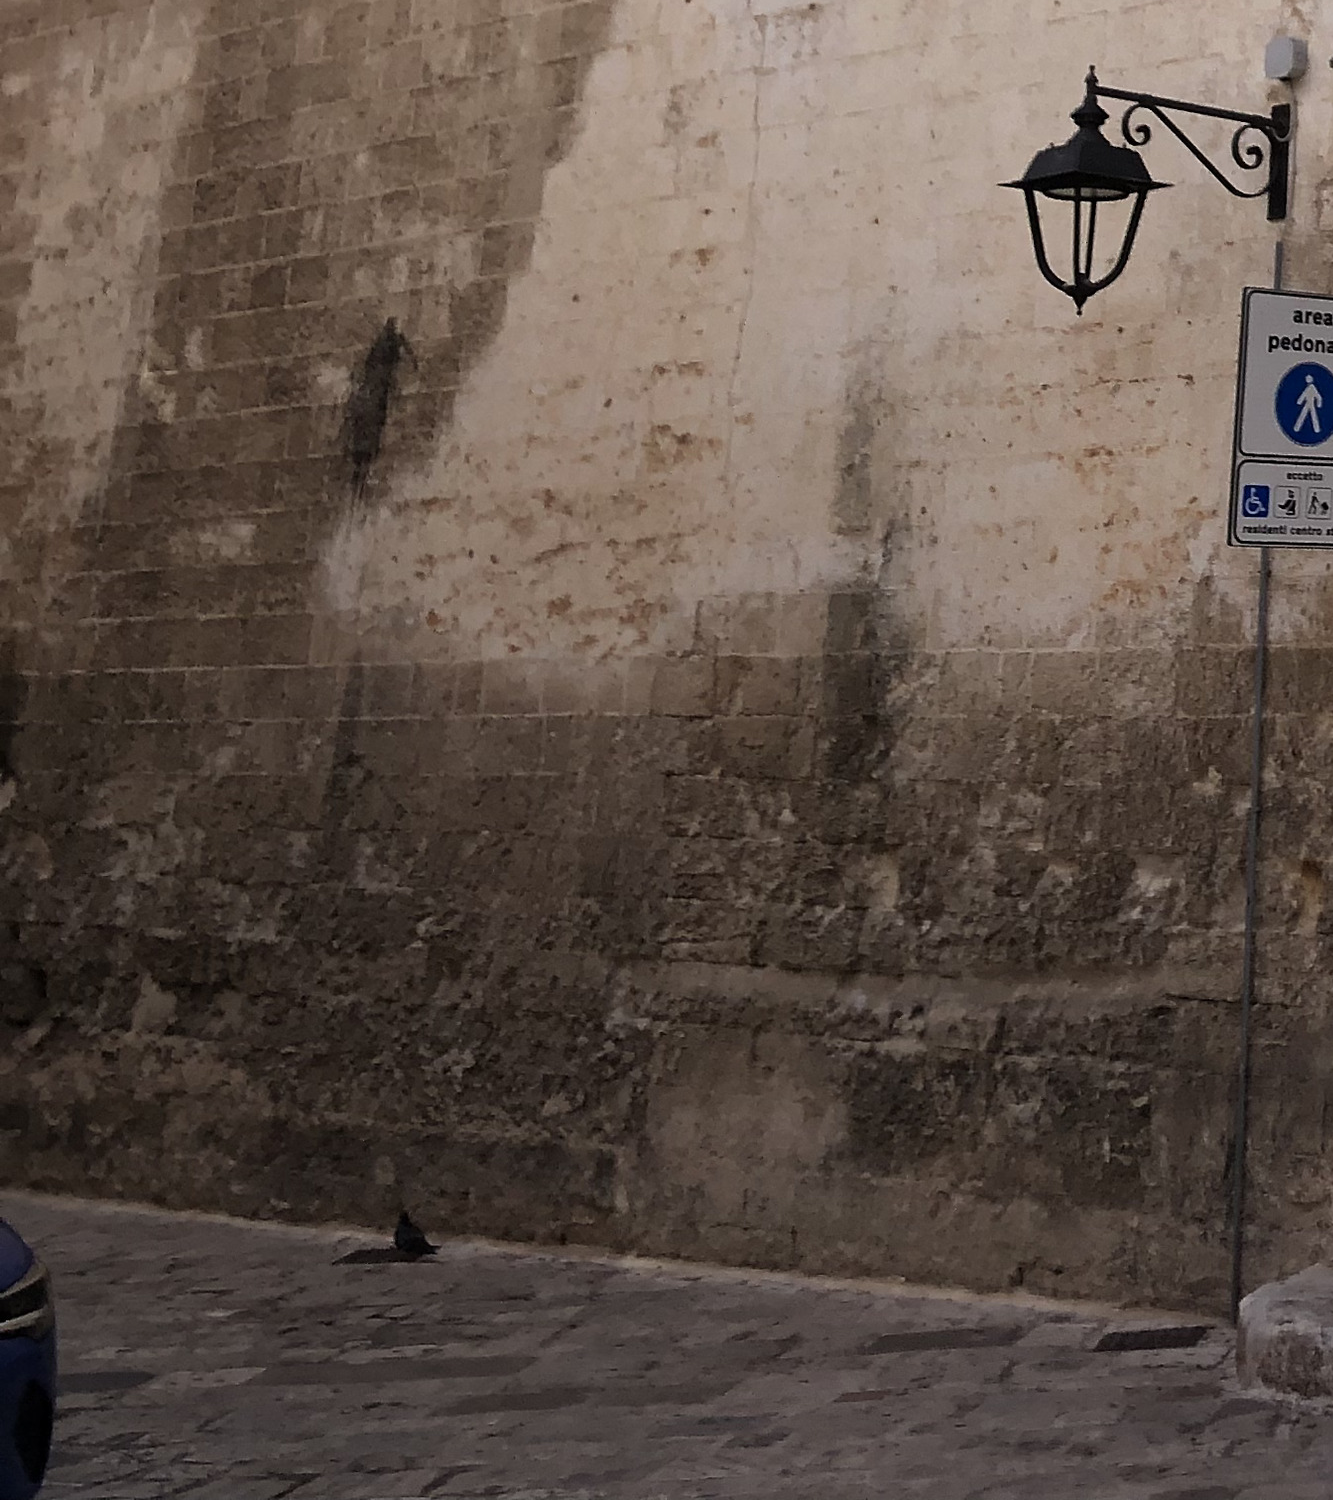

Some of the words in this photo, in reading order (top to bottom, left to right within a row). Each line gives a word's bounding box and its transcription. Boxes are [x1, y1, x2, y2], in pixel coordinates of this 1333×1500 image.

[1293, 309, 1333, 327] area
[1286, 471, 1324, 482] eccetto
[1241, 524, 1288, 536] residenti
[1290, 525, 1323, 537] centro
